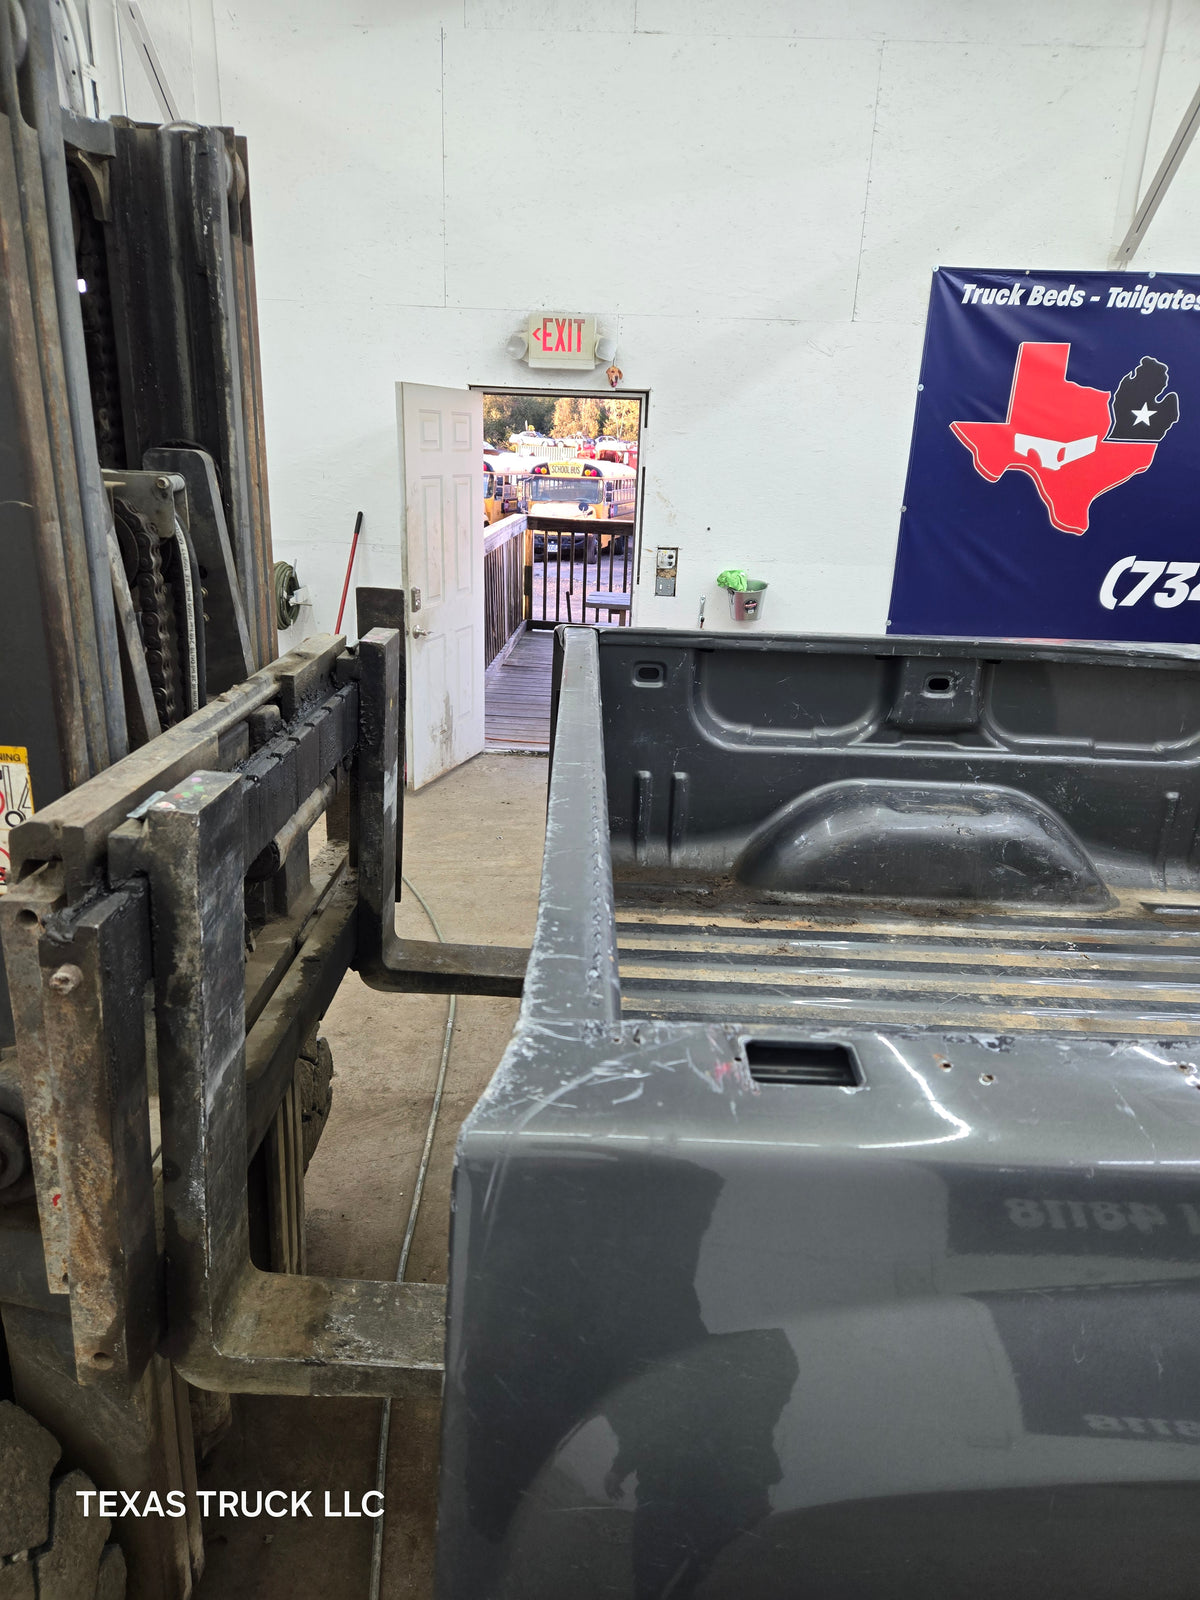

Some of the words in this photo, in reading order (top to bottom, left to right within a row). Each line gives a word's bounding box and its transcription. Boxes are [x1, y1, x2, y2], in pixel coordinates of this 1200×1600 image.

[961, 283, 1026, 306] Truck
[1026, 284, 1086, 307] Beds
[1106, 285, 1200, 314] Tailgates
[542, 317, 585, 352] EXIT
[551, 464, 570, 474] SCHOOL
[570, 465, 580, 475] BUS
